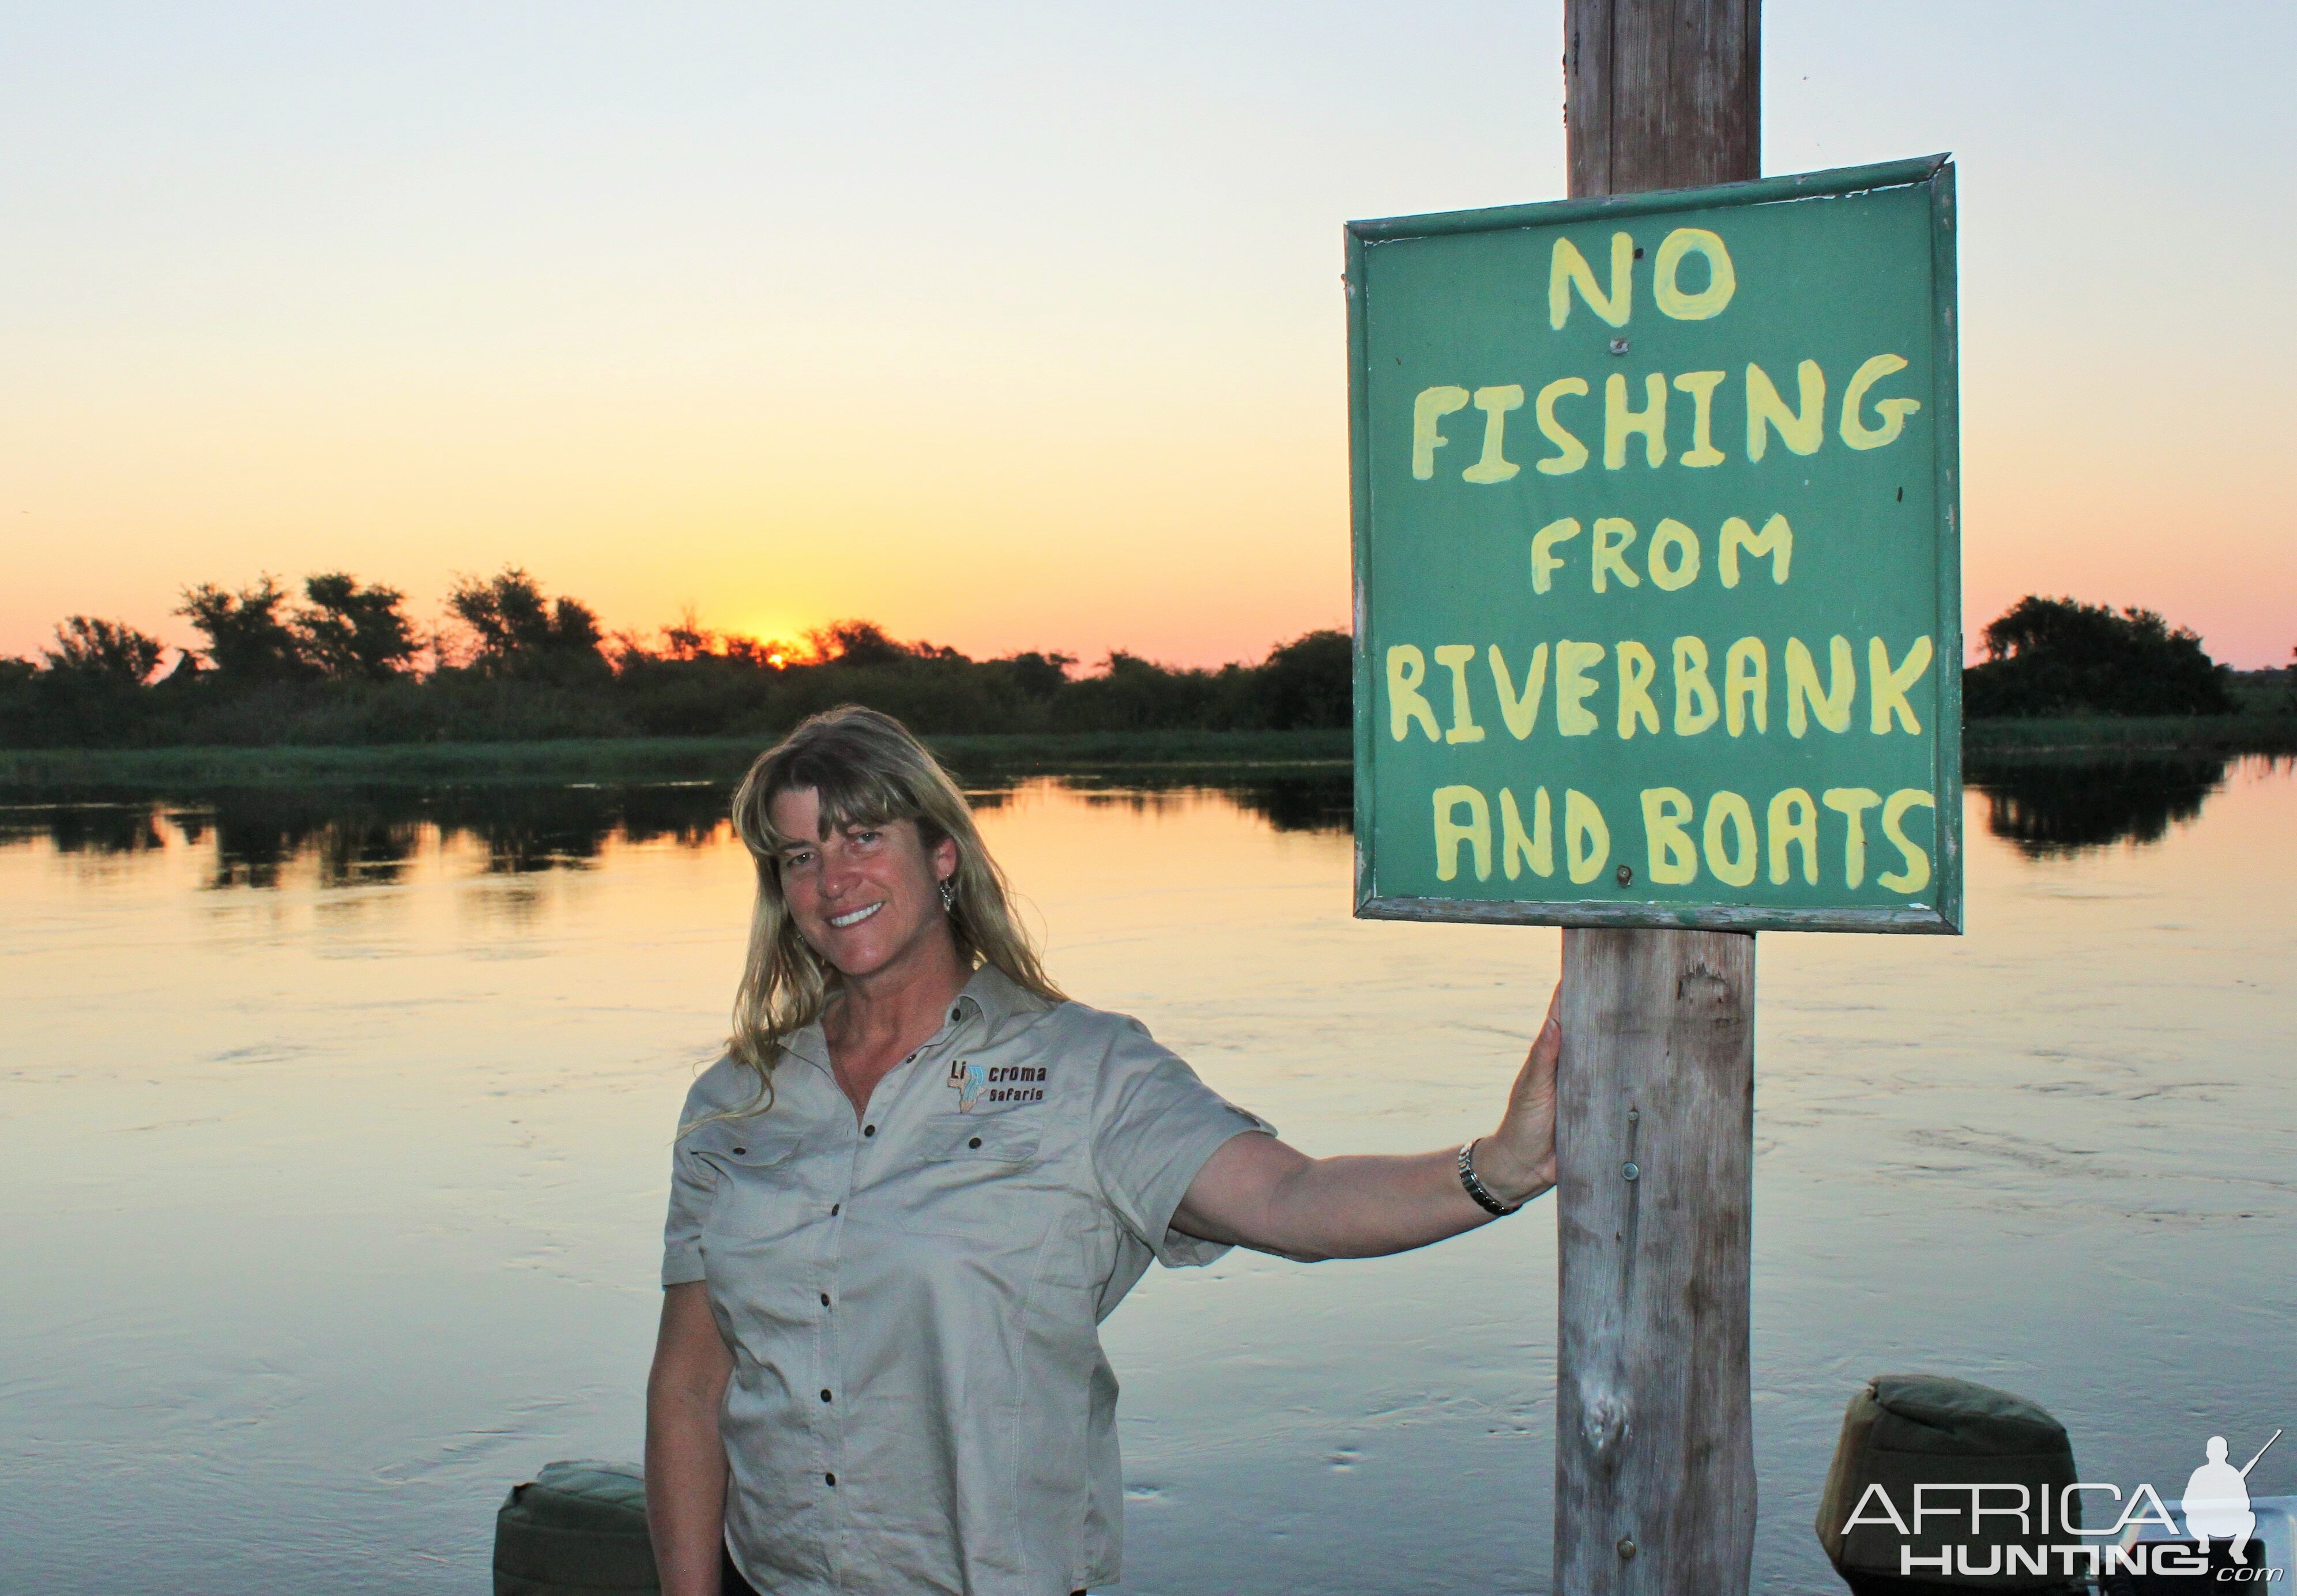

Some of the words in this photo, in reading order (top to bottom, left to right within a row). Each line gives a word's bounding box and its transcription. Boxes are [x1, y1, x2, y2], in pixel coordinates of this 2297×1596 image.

[1549, 227, 1736, 329] NO
[1413, 353, 1921, 483] FISHING
[1531, 514, 1793, 594] FROM
[1387, 635, 1933, 745] RIVERBANK
[1433, 784, 1610, 884] AND
[1641, 787, 1934, 894] BOATS
[951, 1060, 966, 1080] Li
[989, 1088, 1043, 1101] Safaris
